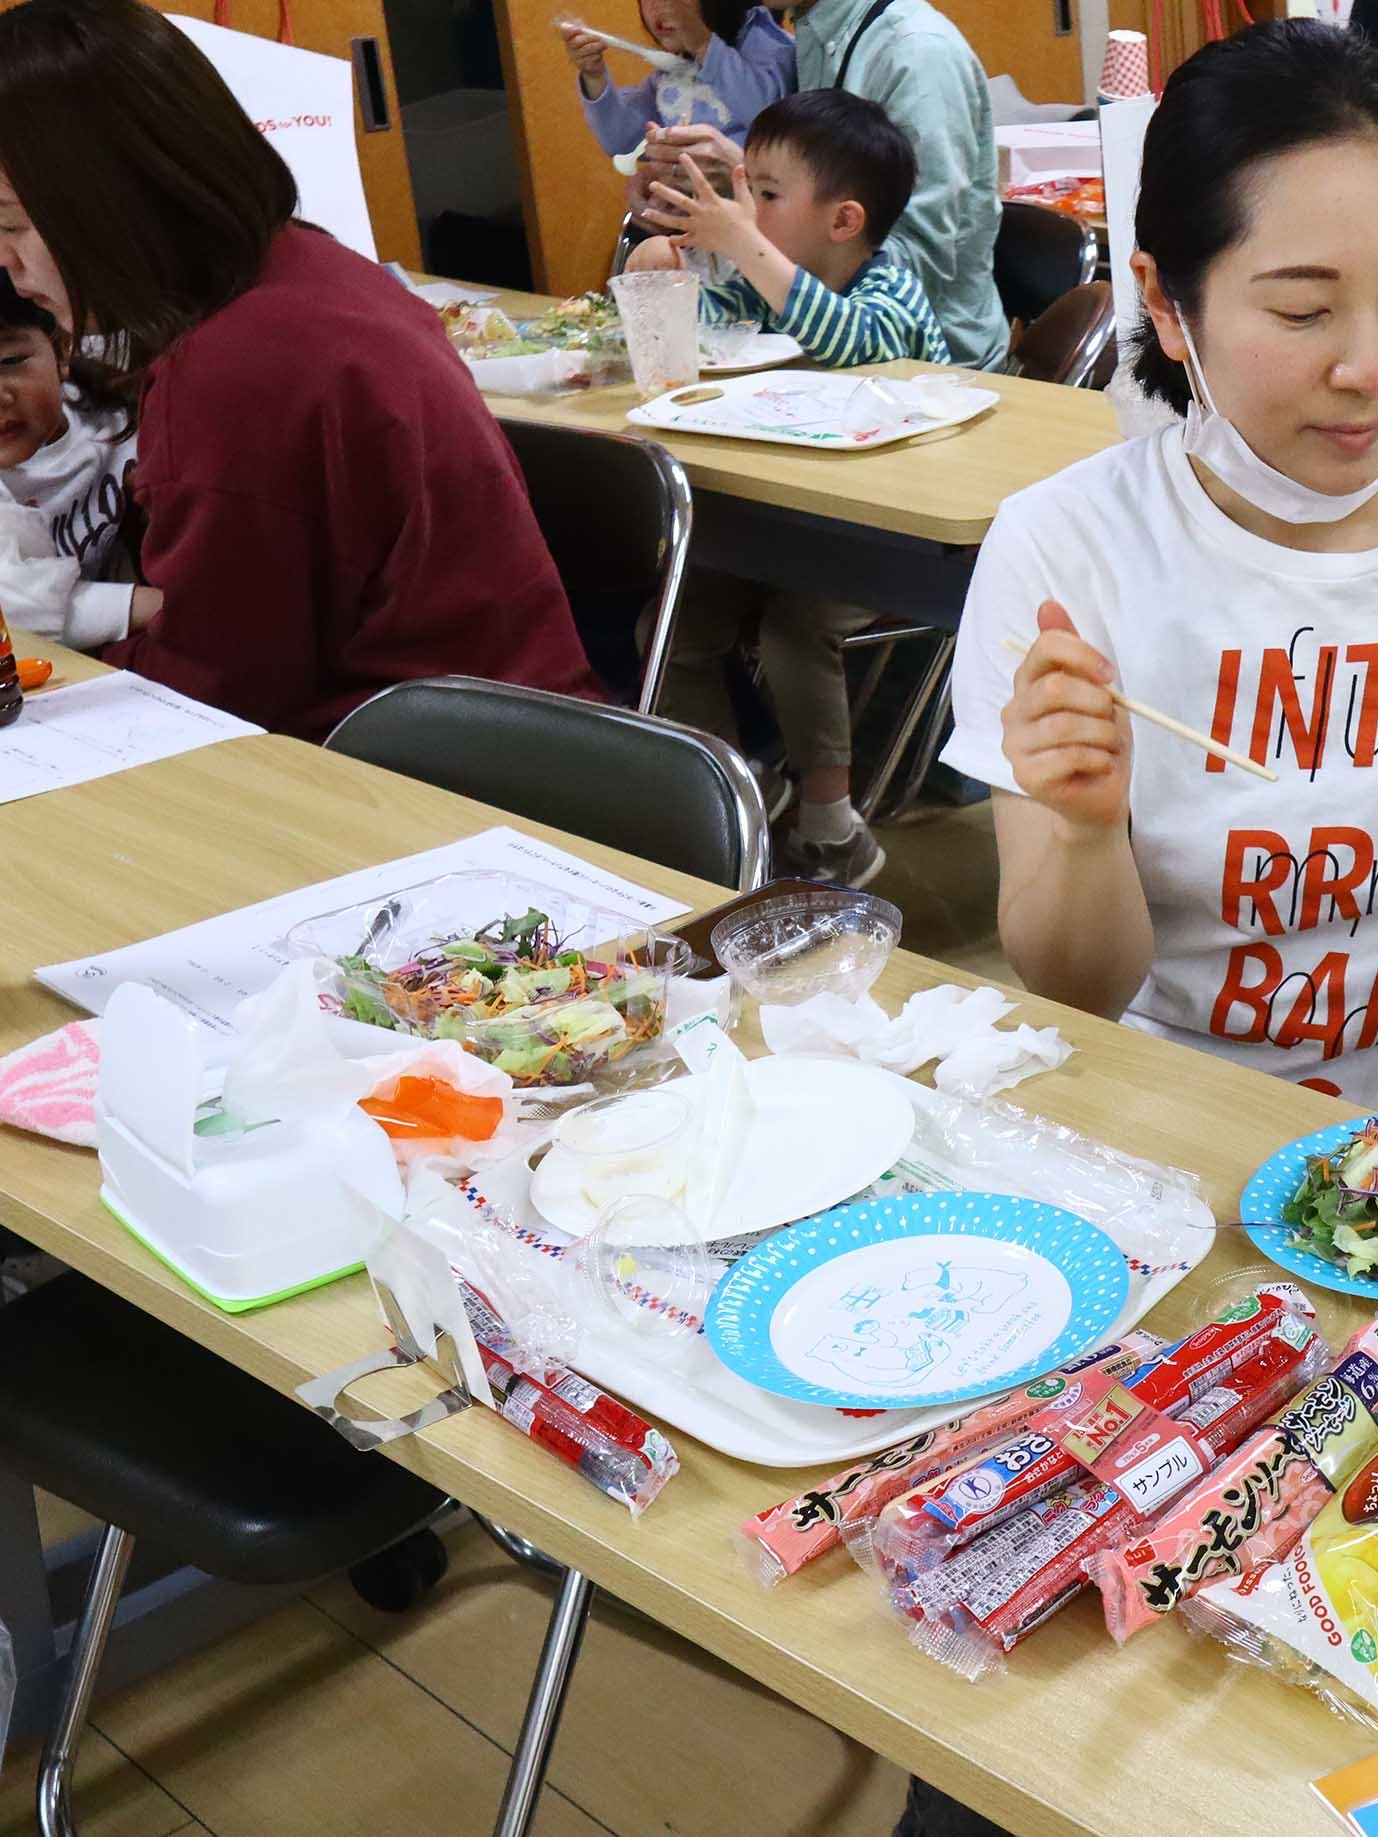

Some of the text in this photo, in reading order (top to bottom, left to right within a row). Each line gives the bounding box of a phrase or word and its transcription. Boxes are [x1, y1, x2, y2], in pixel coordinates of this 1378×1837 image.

[1281, 1377, 1343, 1432] サーモン
[1132, 1453, 1188, 1496] サンプル
[1308, 1595, 1344, 1647] GOOD
